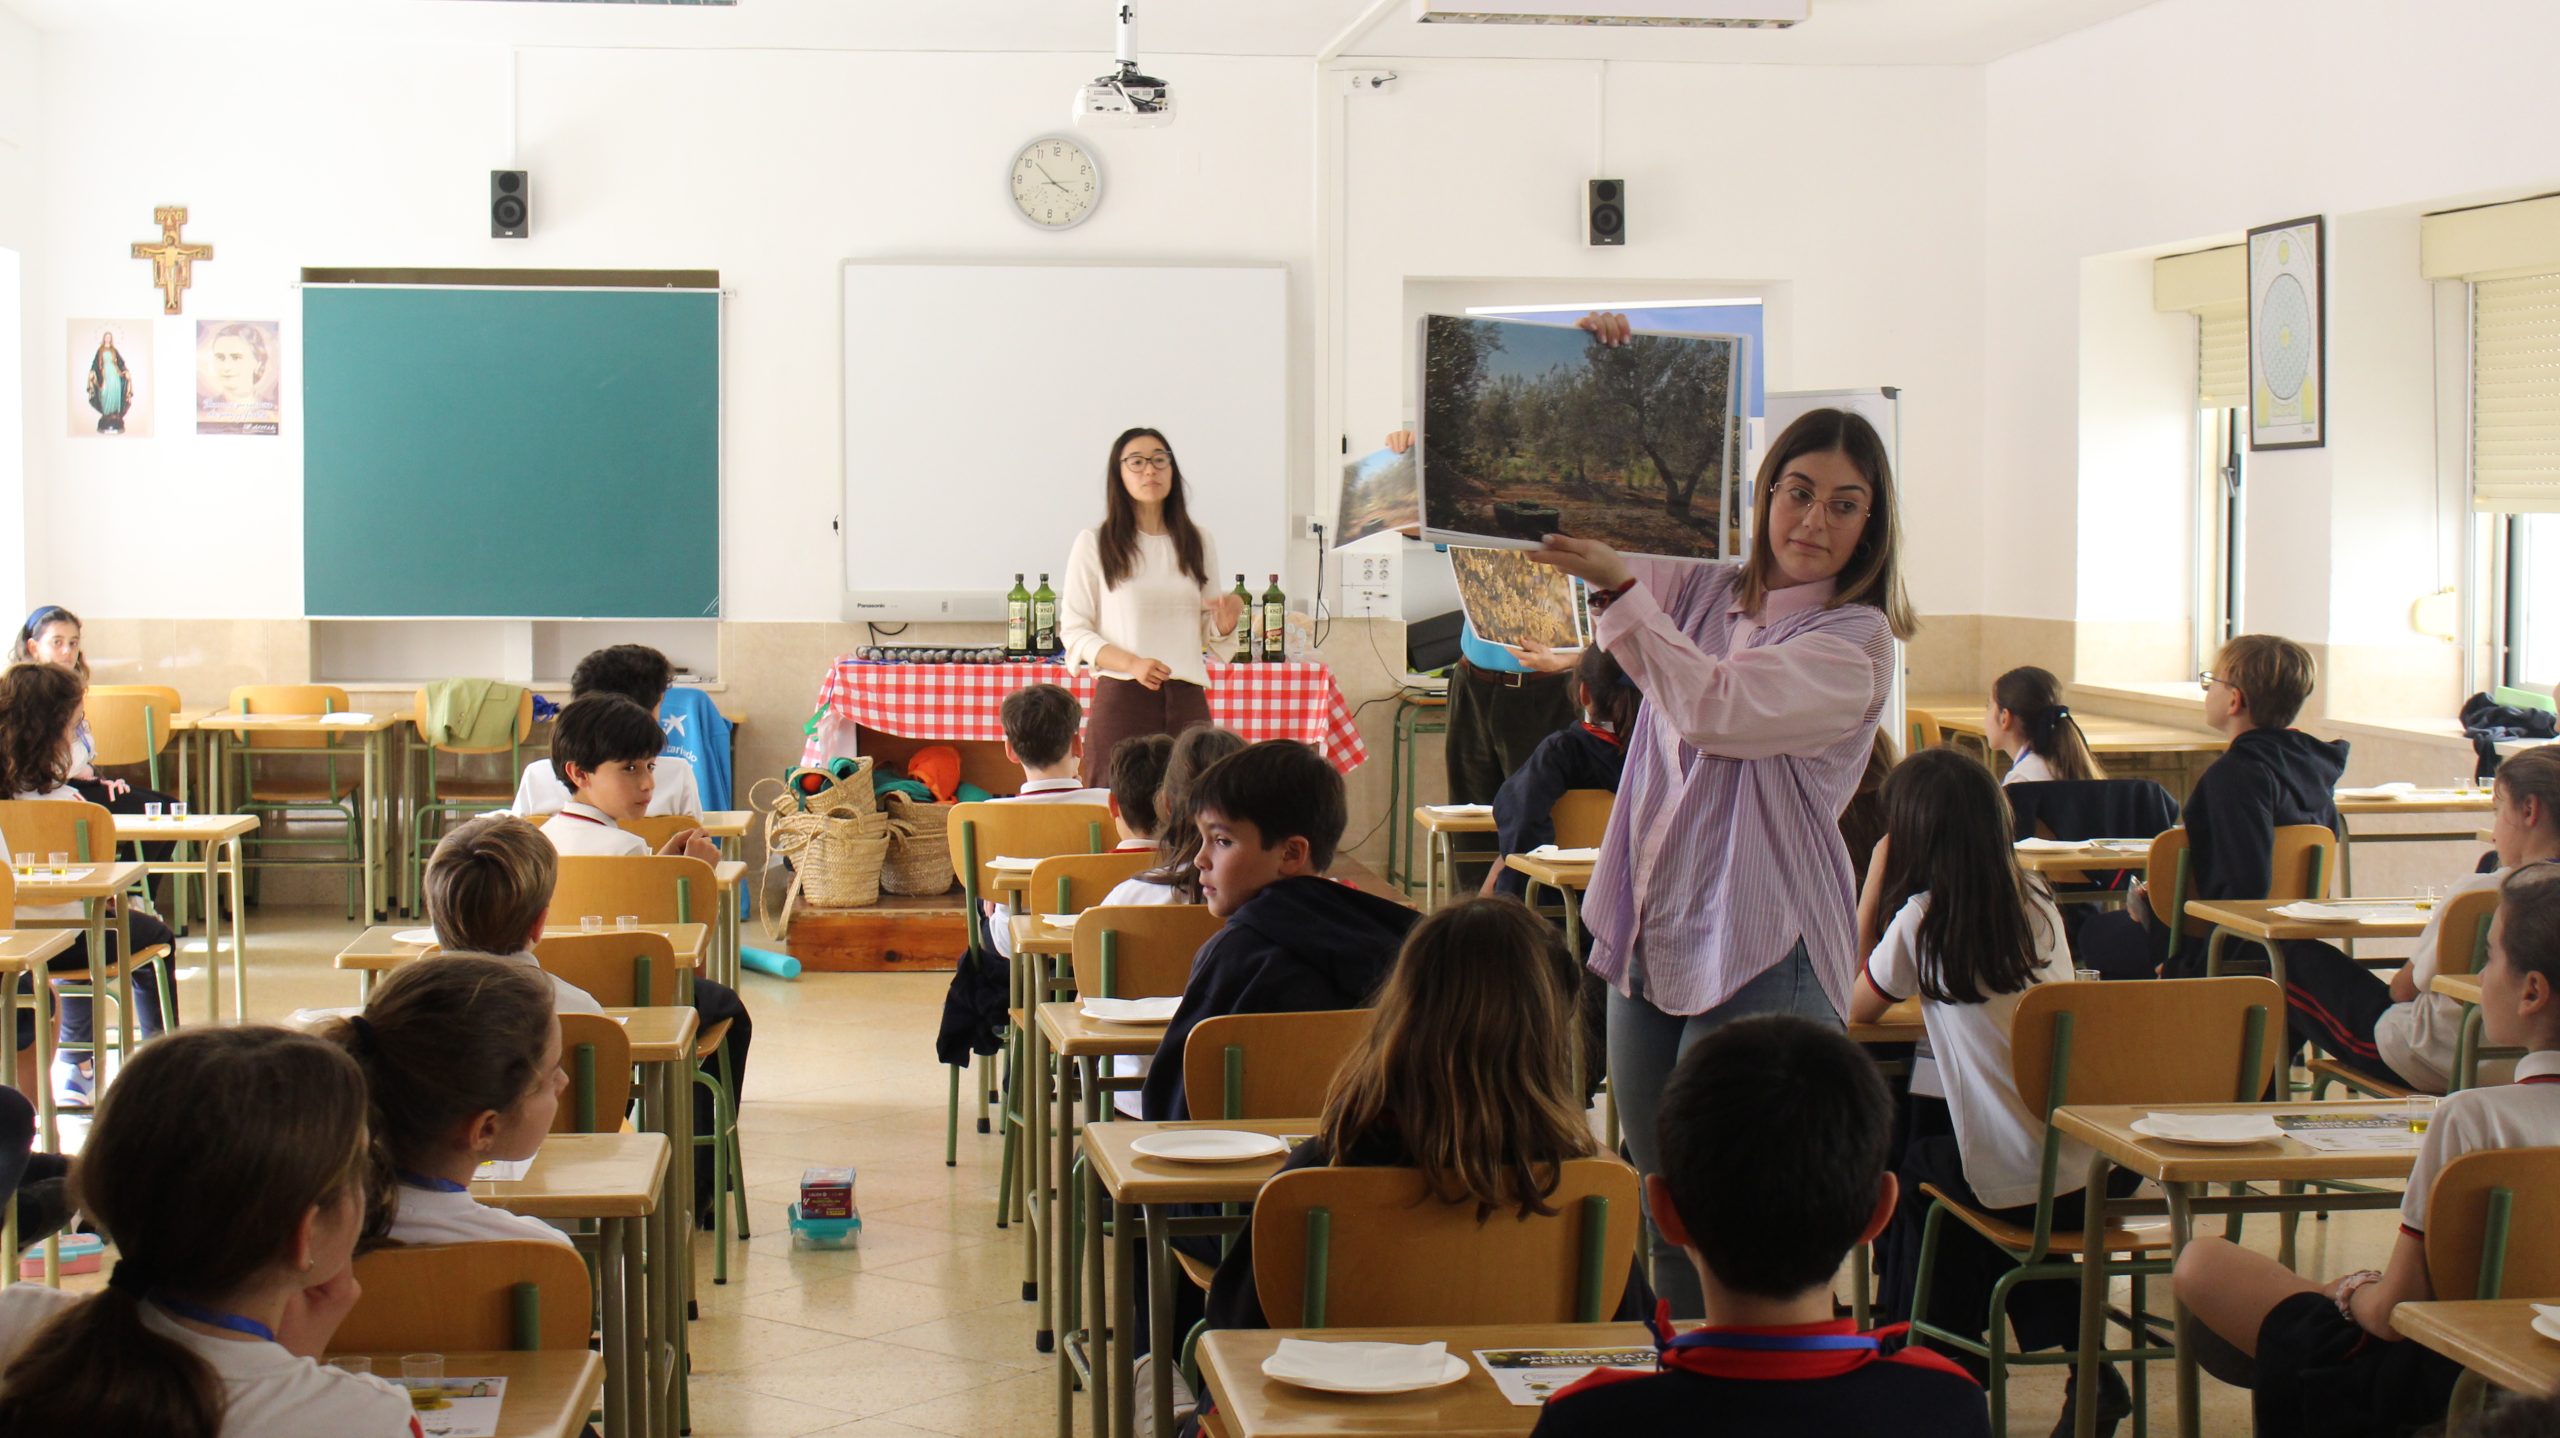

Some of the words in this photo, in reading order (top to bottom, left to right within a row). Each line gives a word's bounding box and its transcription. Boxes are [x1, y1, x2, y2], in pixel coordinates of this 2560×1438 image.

[1037, 149, 1044, 160] 11
[1053, 146, 1061, 157] 12
[1024, 158, 1033, 168] 10
[1080, 165, 1087, 175] 2
[1017, 174, 1023, 184] 9
[1084, 182, 1090, 192] 3
